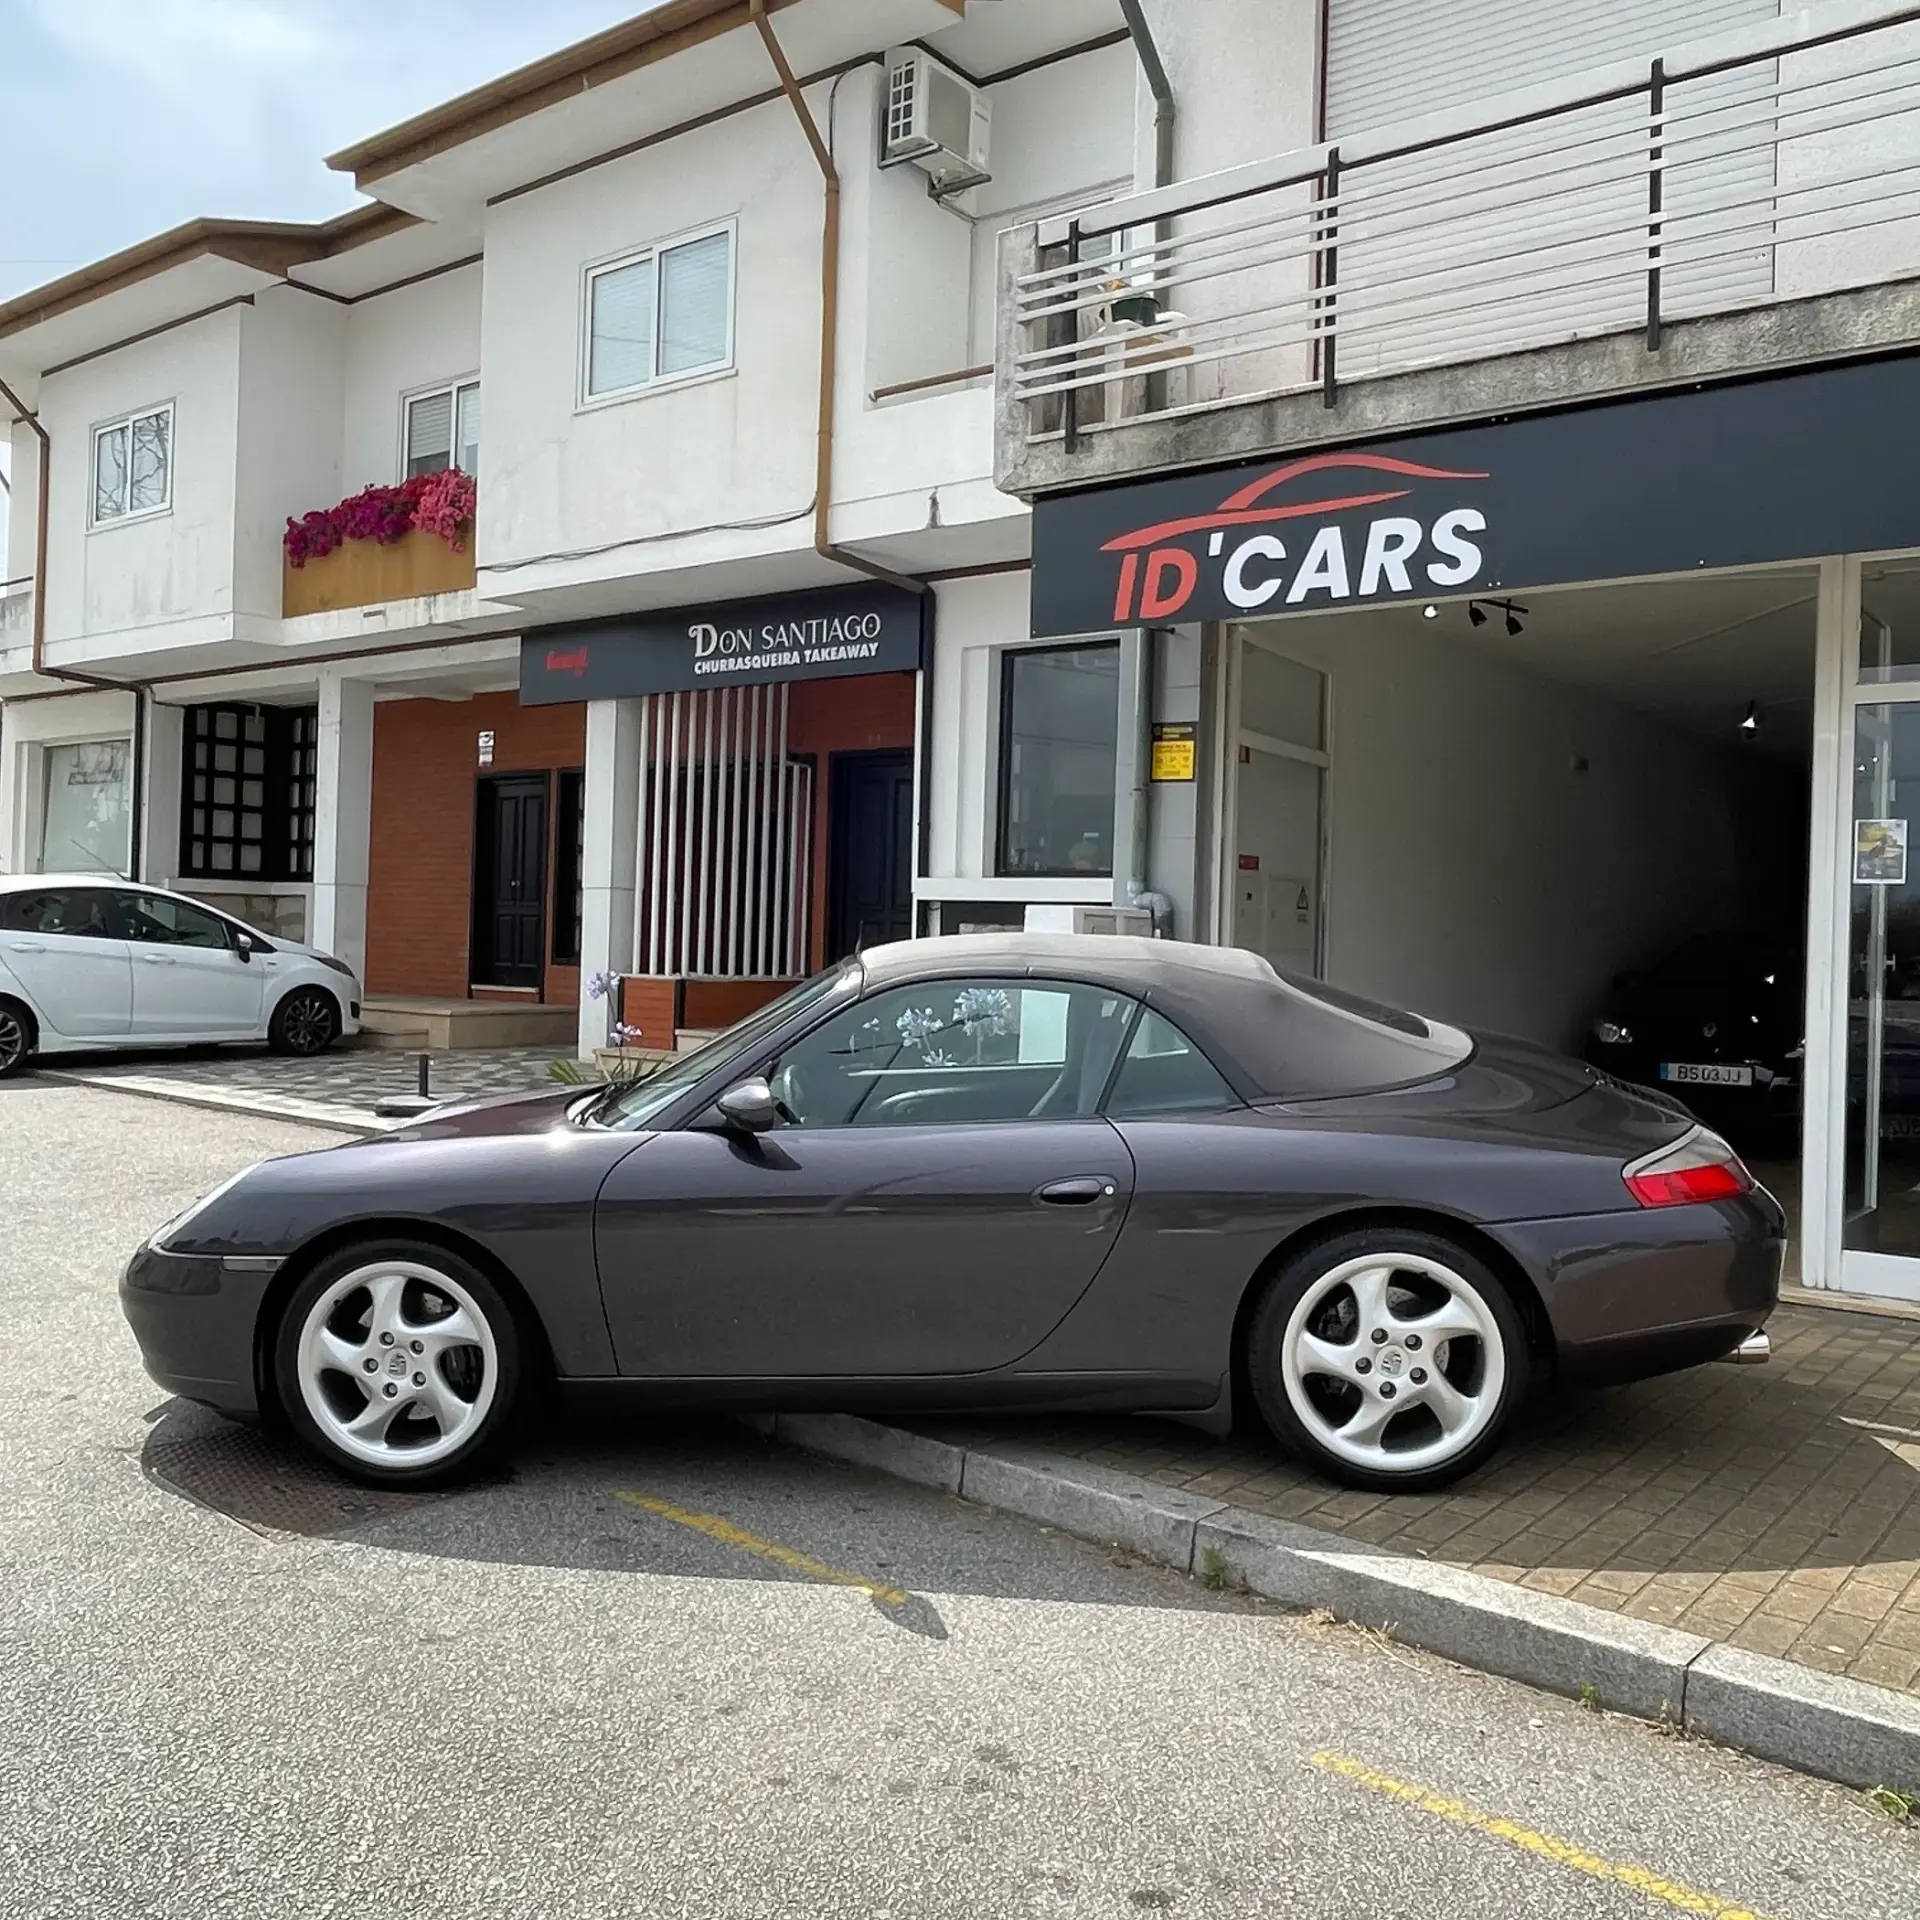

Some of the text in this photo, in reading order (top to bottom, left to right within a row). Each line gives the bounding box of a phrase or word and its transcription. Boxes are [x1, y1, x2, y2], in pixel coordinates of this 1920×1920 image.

[761, 613, 881, 650] SANTIAGO
[694, 641, 879, 675] CHURRASQUEIRA TAKEAWAY
